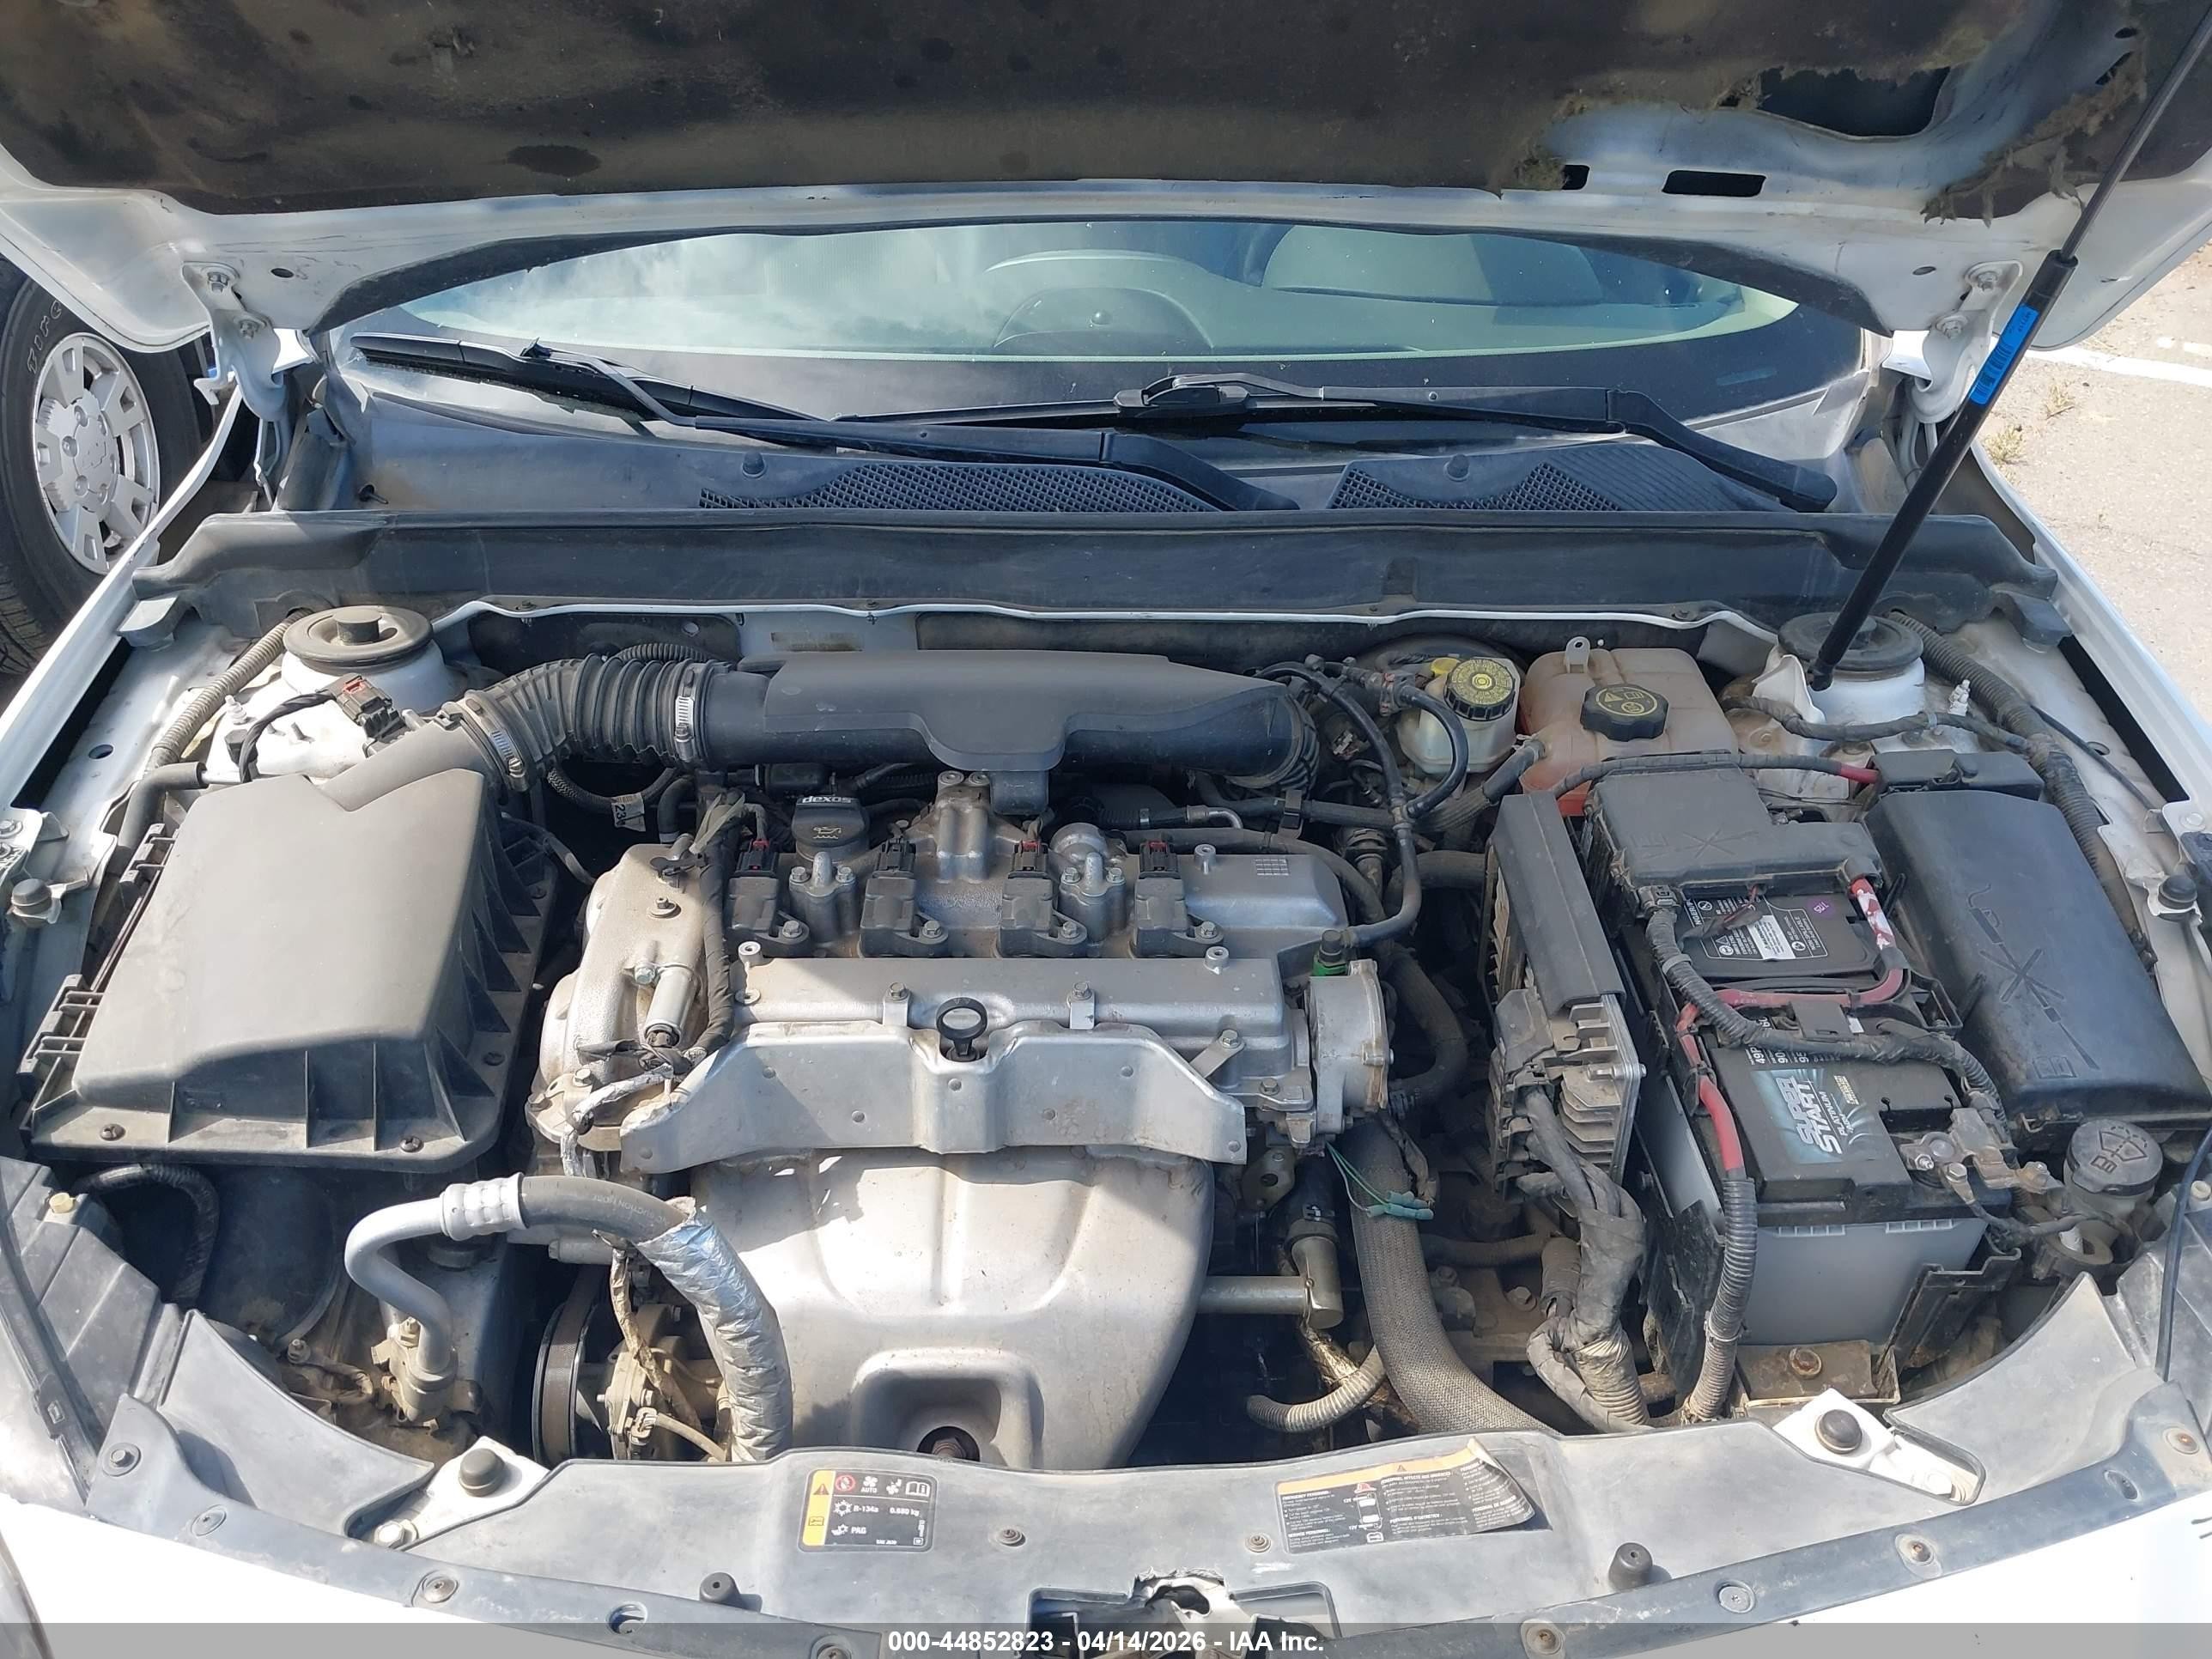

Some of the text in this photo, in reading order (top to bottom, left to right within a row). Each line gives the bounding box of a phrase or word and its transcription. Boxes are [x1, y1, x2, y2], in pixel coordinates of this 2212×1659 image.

[1749, 1047, 1766, 1065] 49P
[1776, 1077, 1816, 1145] SUPER
[1796, 1082, 1843, 1154] START
[1820, 1091, 1849, 1136] PLATINUM
[854, 1504, 879, 1513] R-134a
